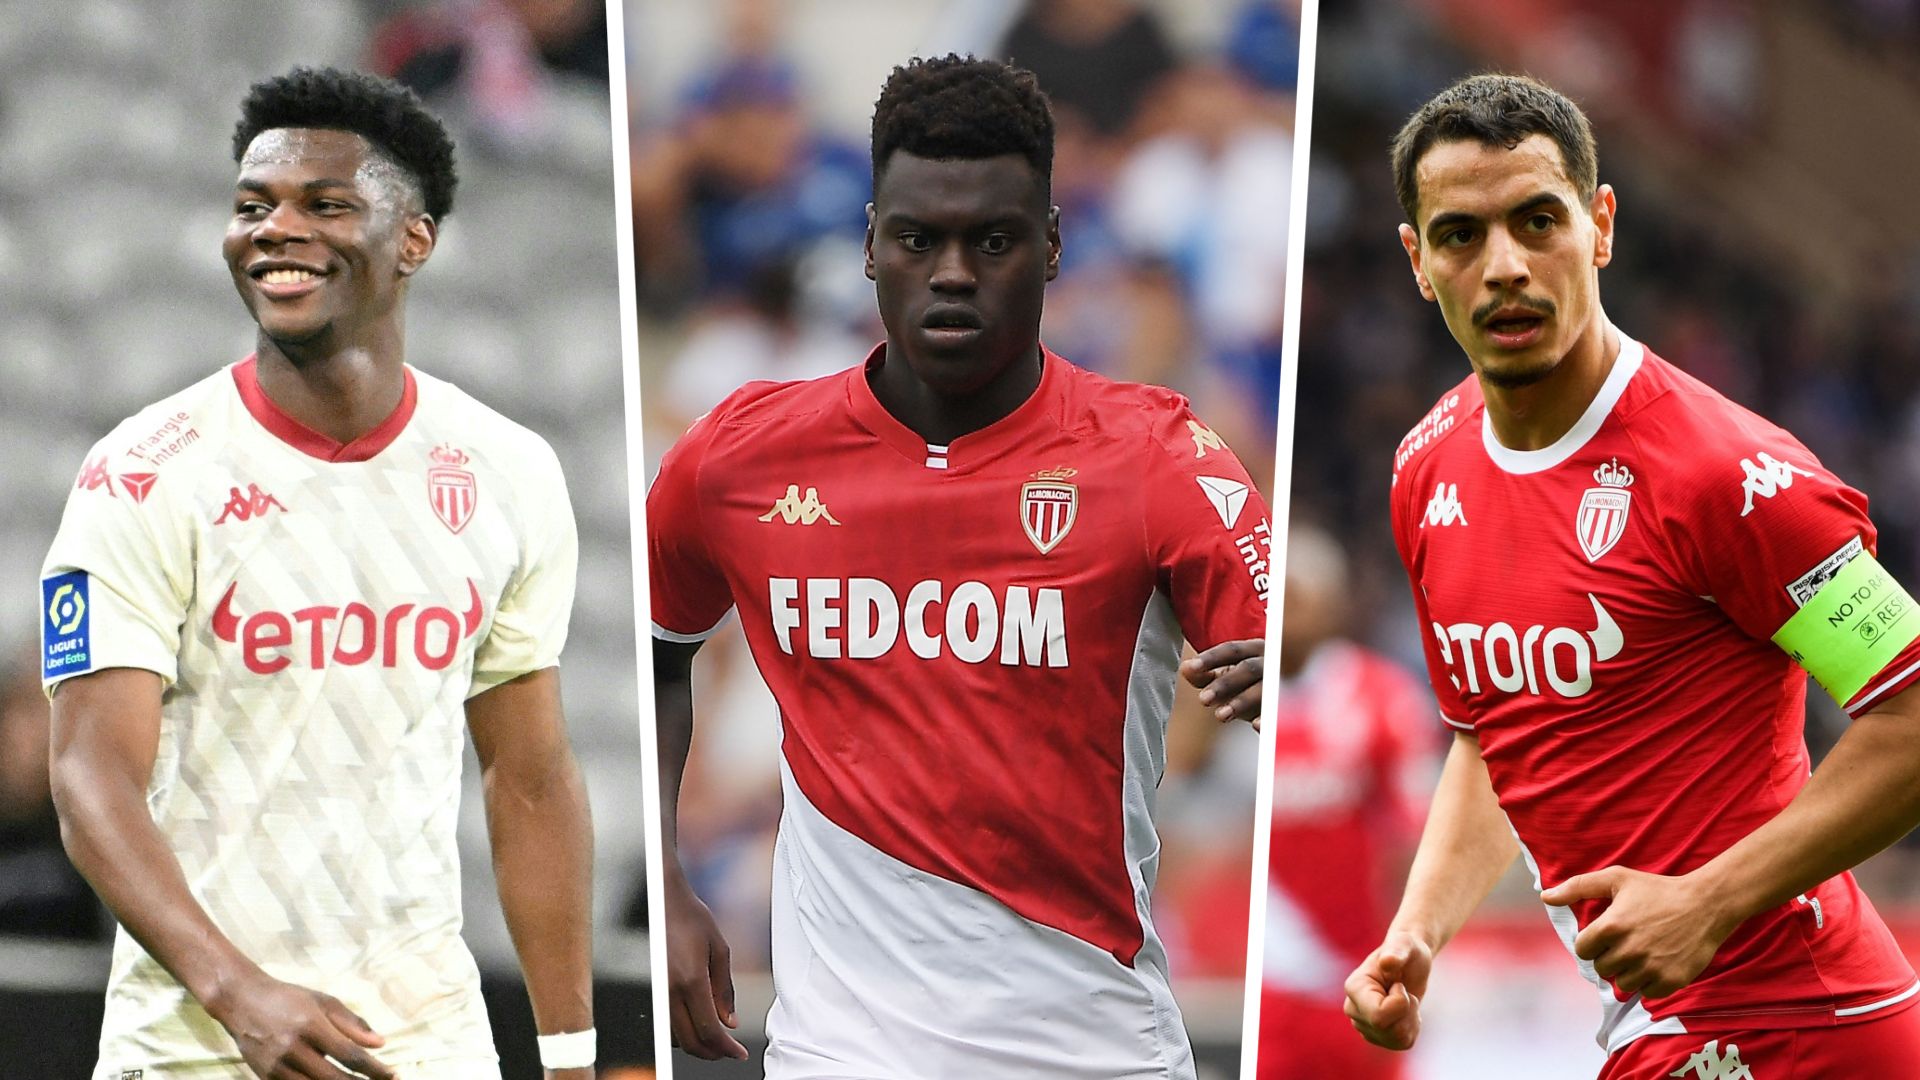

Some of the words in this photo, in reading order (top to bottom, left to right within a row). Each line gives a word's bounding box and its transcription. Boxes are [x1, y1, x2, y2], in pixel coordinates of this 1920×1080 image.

[126, 412, 190, 459] Triangle
[769, 577, 1069, 668] FEDCOM
[1828, 603, 1853, 628] NO
[1850, 586, 1871, 604] TO
[49, 638, 77, 655] LIGUE
[77, 637, 84, 648] 1
[65, 652, 87, 665] Eats
